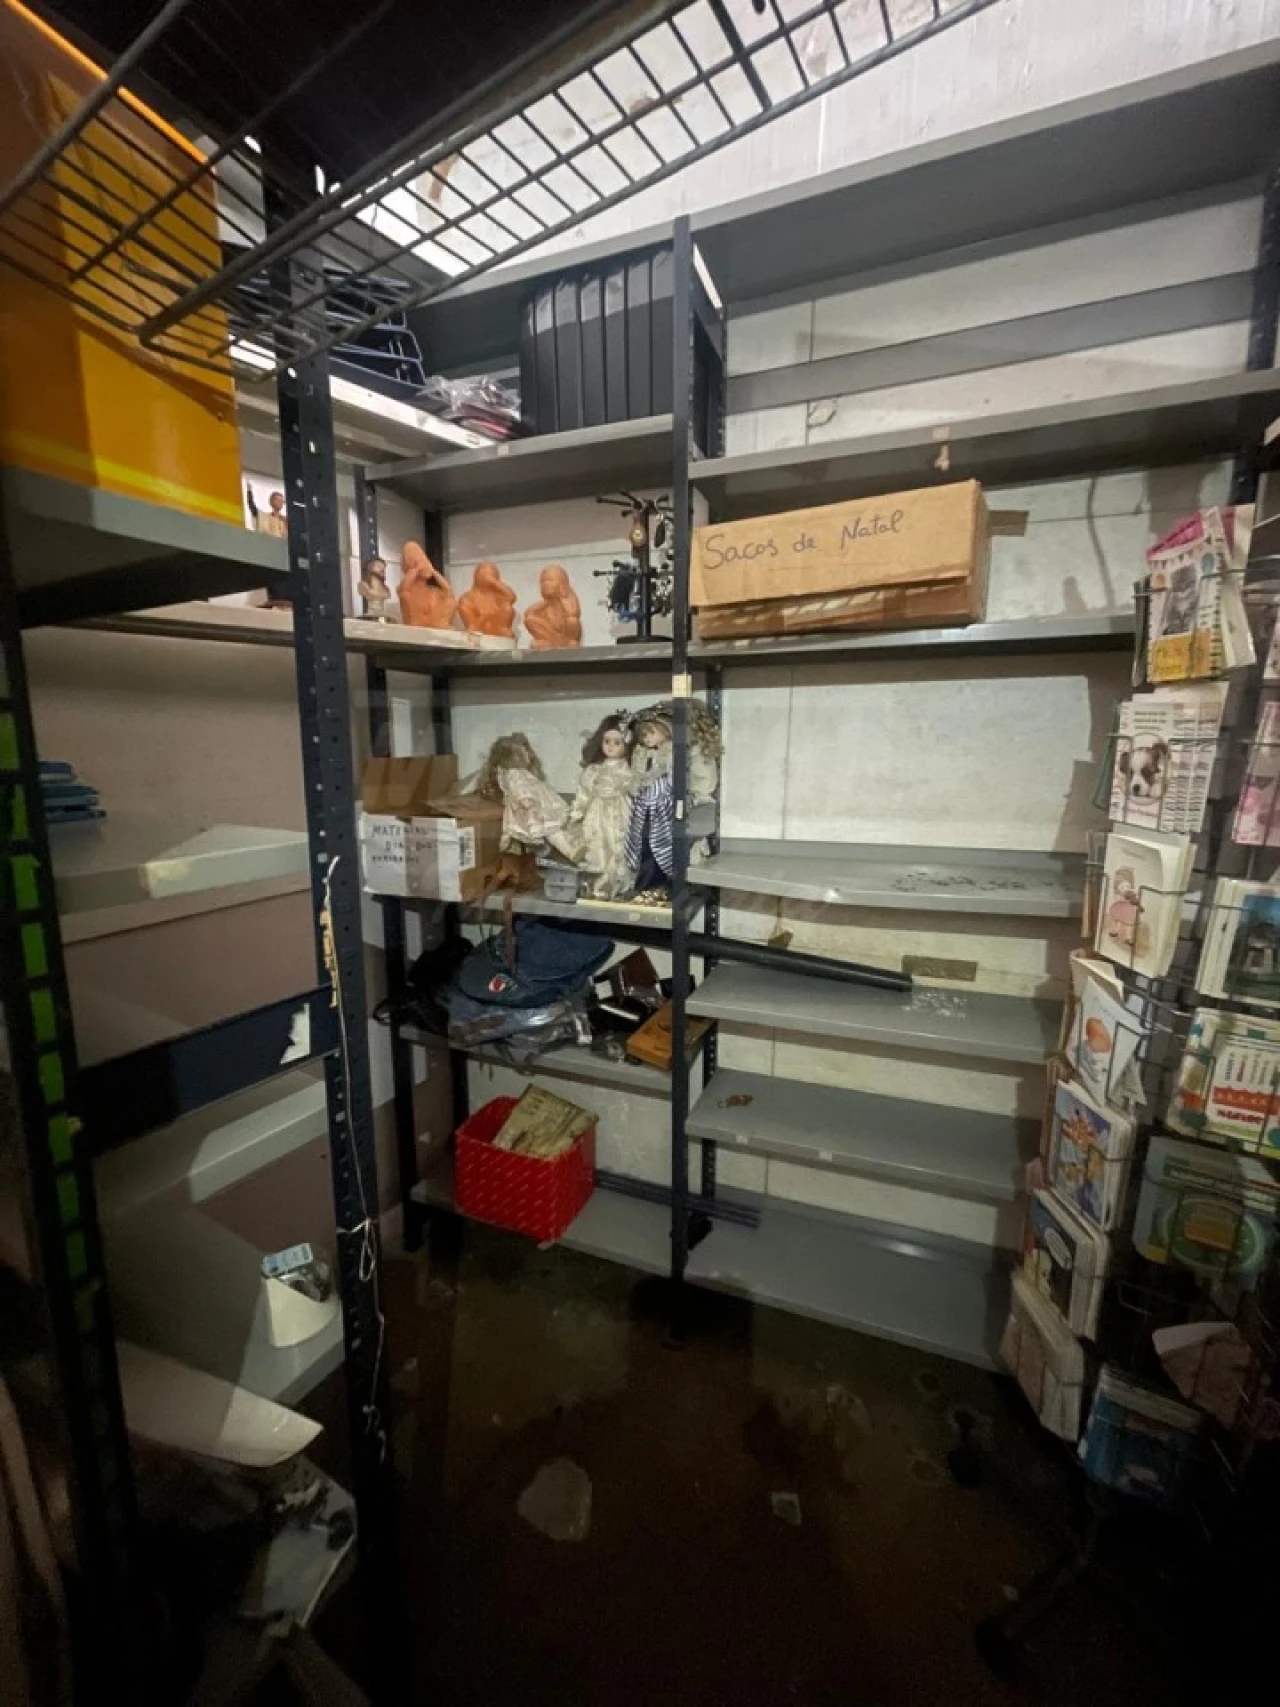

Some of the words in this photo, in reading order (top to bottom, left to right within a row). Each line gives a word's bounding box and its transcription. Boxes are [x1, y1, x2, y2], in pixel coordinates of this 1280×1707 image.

[704, 533, 779, 570] Sacos
[793, 532, 817, 553] de
[840, 509, 904, 550] Natal
